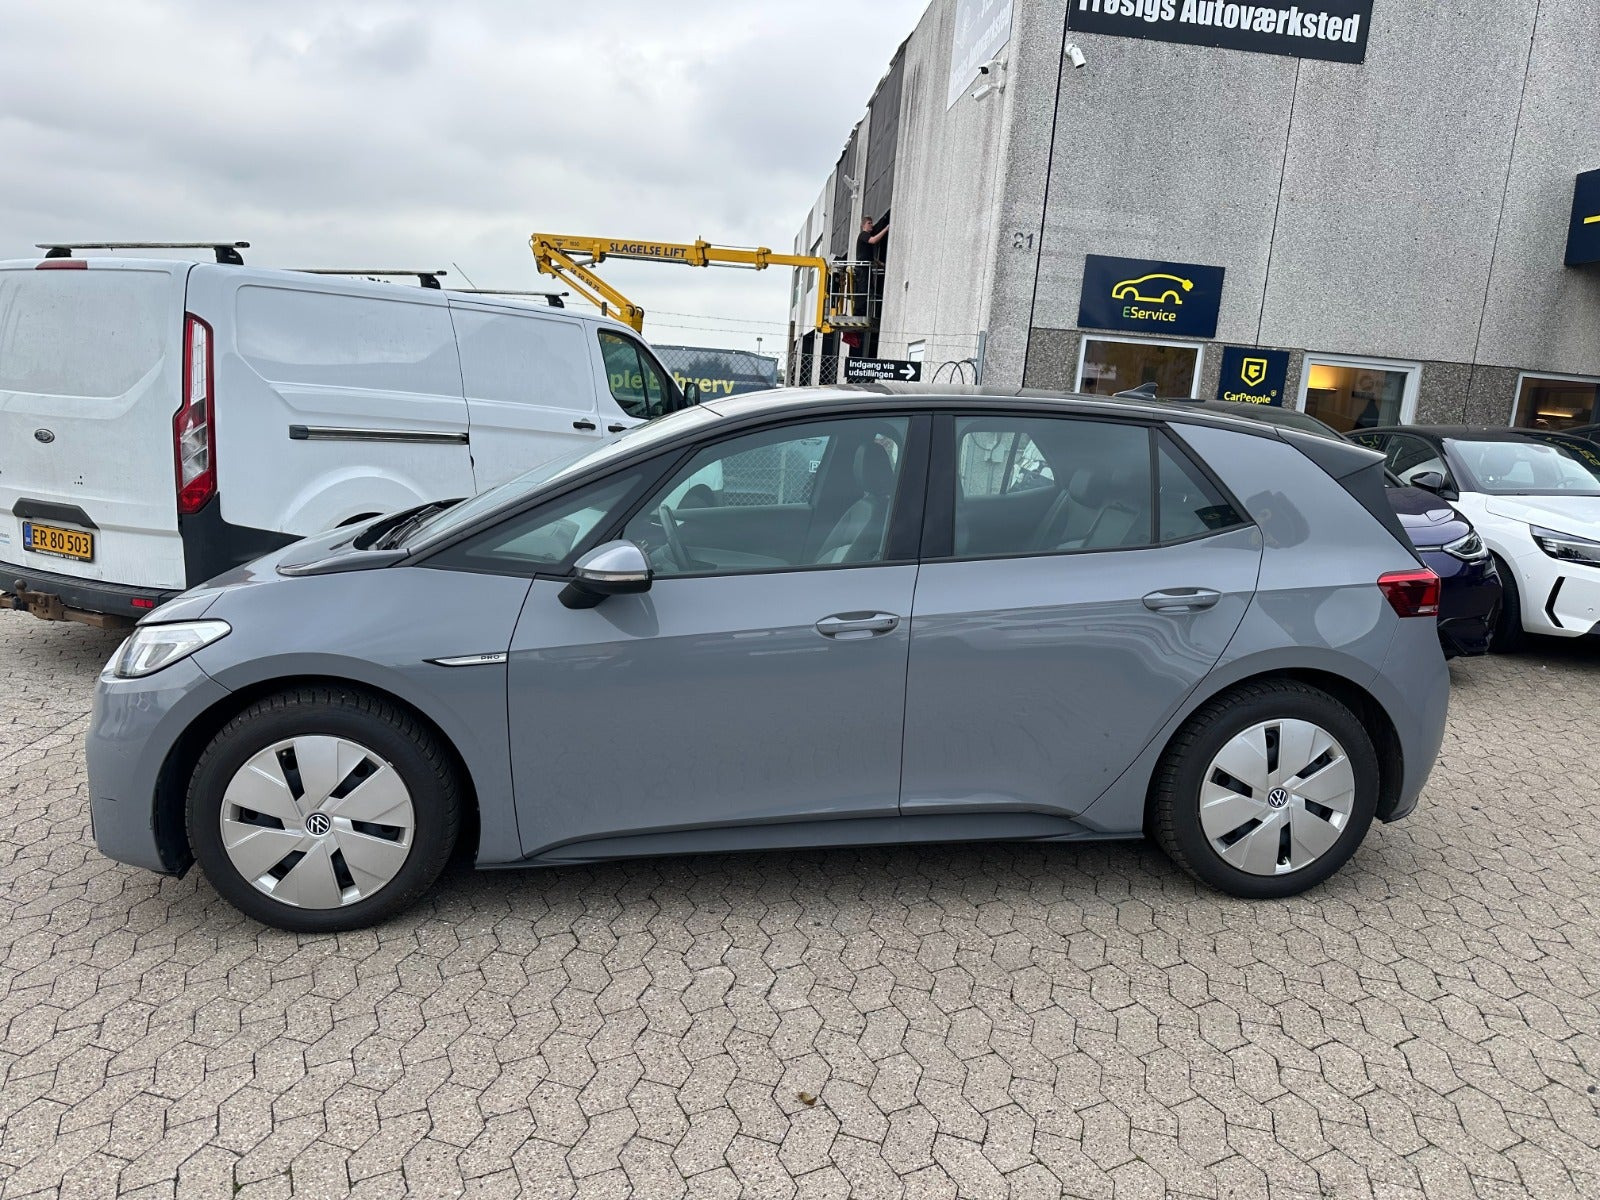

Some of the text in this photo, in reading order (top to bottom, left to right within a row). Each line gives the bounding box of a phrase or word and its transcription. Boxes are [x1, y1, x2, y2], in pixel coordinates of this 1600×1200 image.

[1180, 0, 1360, 43] Autoværksted
[609, 242, 687, 258] SLAGELSE LIFT
[1122, 306, 1176, 322] EService
[849, 360, 881, 370] Indgang
[848, 369, 894, 379] udstillingen
[32, 528, 89, 554] ER 80 503
